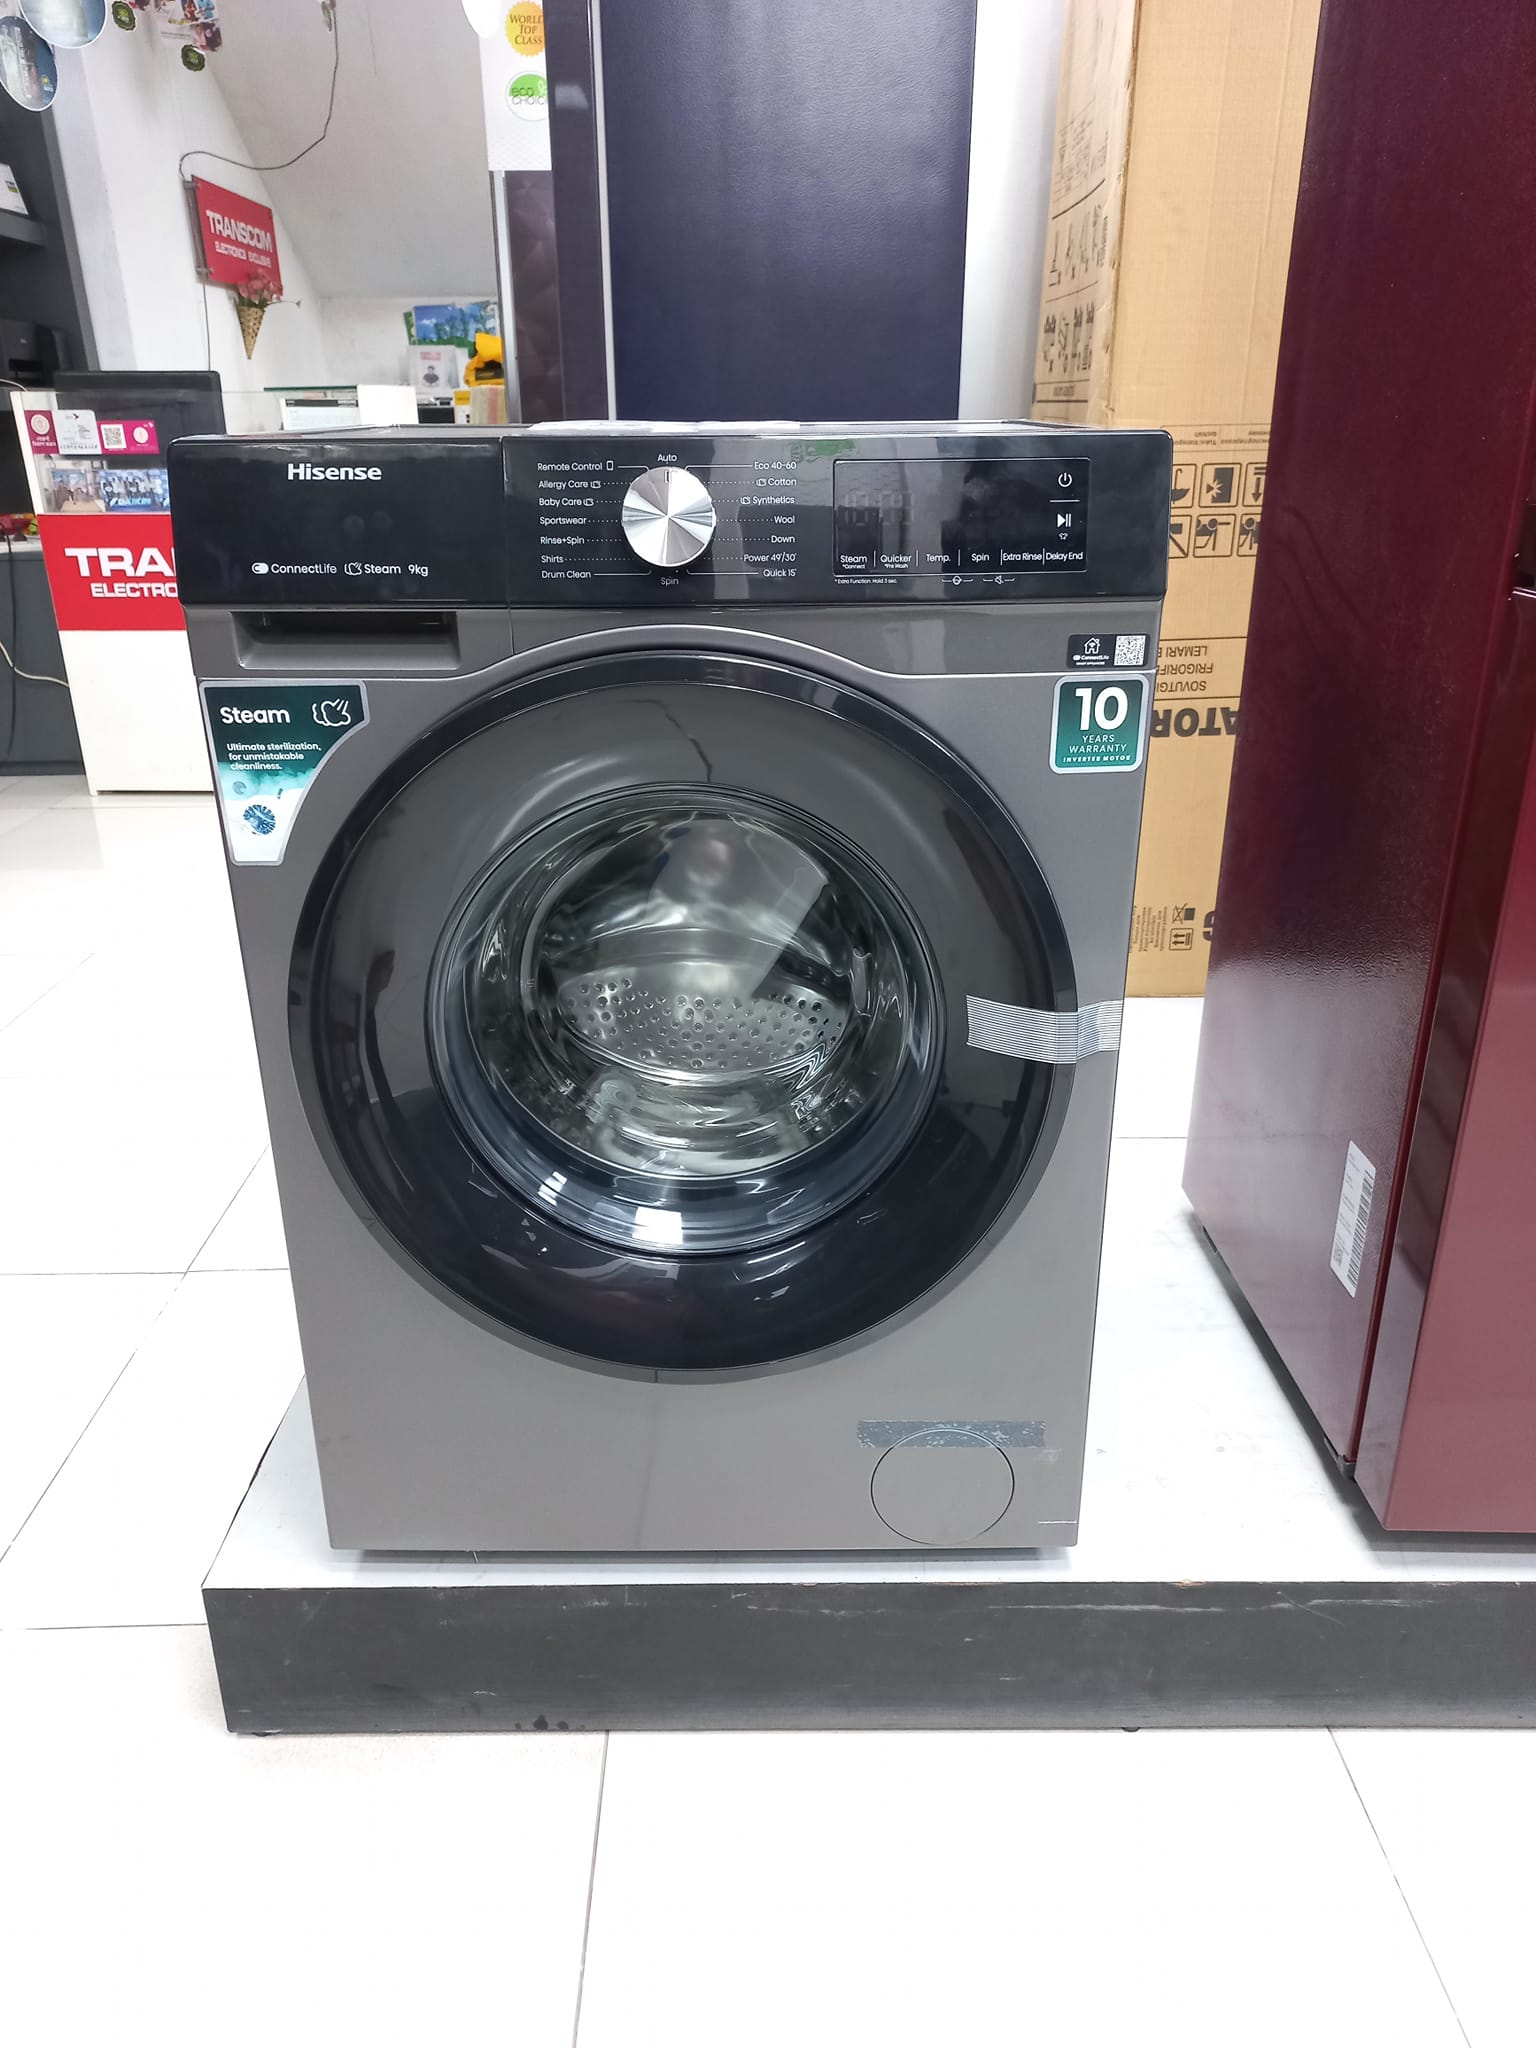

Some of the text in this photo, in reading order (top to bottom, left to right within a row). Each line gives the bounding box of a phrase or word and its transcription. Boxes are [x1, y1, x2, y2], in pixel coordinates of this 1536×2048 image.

[520, 25, 537, 34] TOP
[515, 35, 542, 45] CLASS
[512, 88, 534, 97] eco
[512, 97, 547, 105] CHOIC
[206, 210, 272, 253] TRANSCOM
[657, 454, 678, 463] Auto
[537, 462, 602, 471] Remote Control
[754, 461, 797, 470] Eco 40-60
[287, 463, 382, 481] Hisense
[538, 480, 588, 490] Allergy Care
[768, 478, 797, 486] Cotton
[539, 498, 582, 508] Baby Care
[752, 496, 795, 507] Synthetics
[539, 516, 587, 527] Sportswear
[774, 515, 795, 524] Wool
[540, 536, 585, 546] Rinse+Spin
[771, 535, 795, 543] Down
[541, 555, 564, 563] Shirts
[743, 554, 769, 562] Power
[840, 554, 868, 563] Steam
[880, 554, 912, 563] Quicker
[926, 553, 951, 563] Temp.
[971, 553, 990, 563] Spin
[1002, 552, 1042, 561] Extra Rinse
[1045, 552, 1084, 562] Delay End
[64, 547, 176, 577] TRA
[271, 563, 338, 574] ConnectLife
[363, 563, 402, 574] Steam
[408, 564, 429, 577] 9kg
[763, 569, 787, 577] Quick
[541, 570, 592, 579] Drum Clean
[660, 577, 679, 586] Spin
[90, 583, 178, 598] ELECTRO
[1166, 645, 1208, 658] LEMARI
[1075, 686, 1128, 731] 10
[220, 706, 290, 724] Steam
[1150, 706, 1240, 738] ATOR
[1082, 734, 1115, 743] YEARS
[226, 742, 322, 752] Ultimate sterilization,
[1068, 743, 1127, 753] WARRANTY
[228, 752, 305, 761] for unmistakable
[230, 762, 283, 770] cleanliness.
